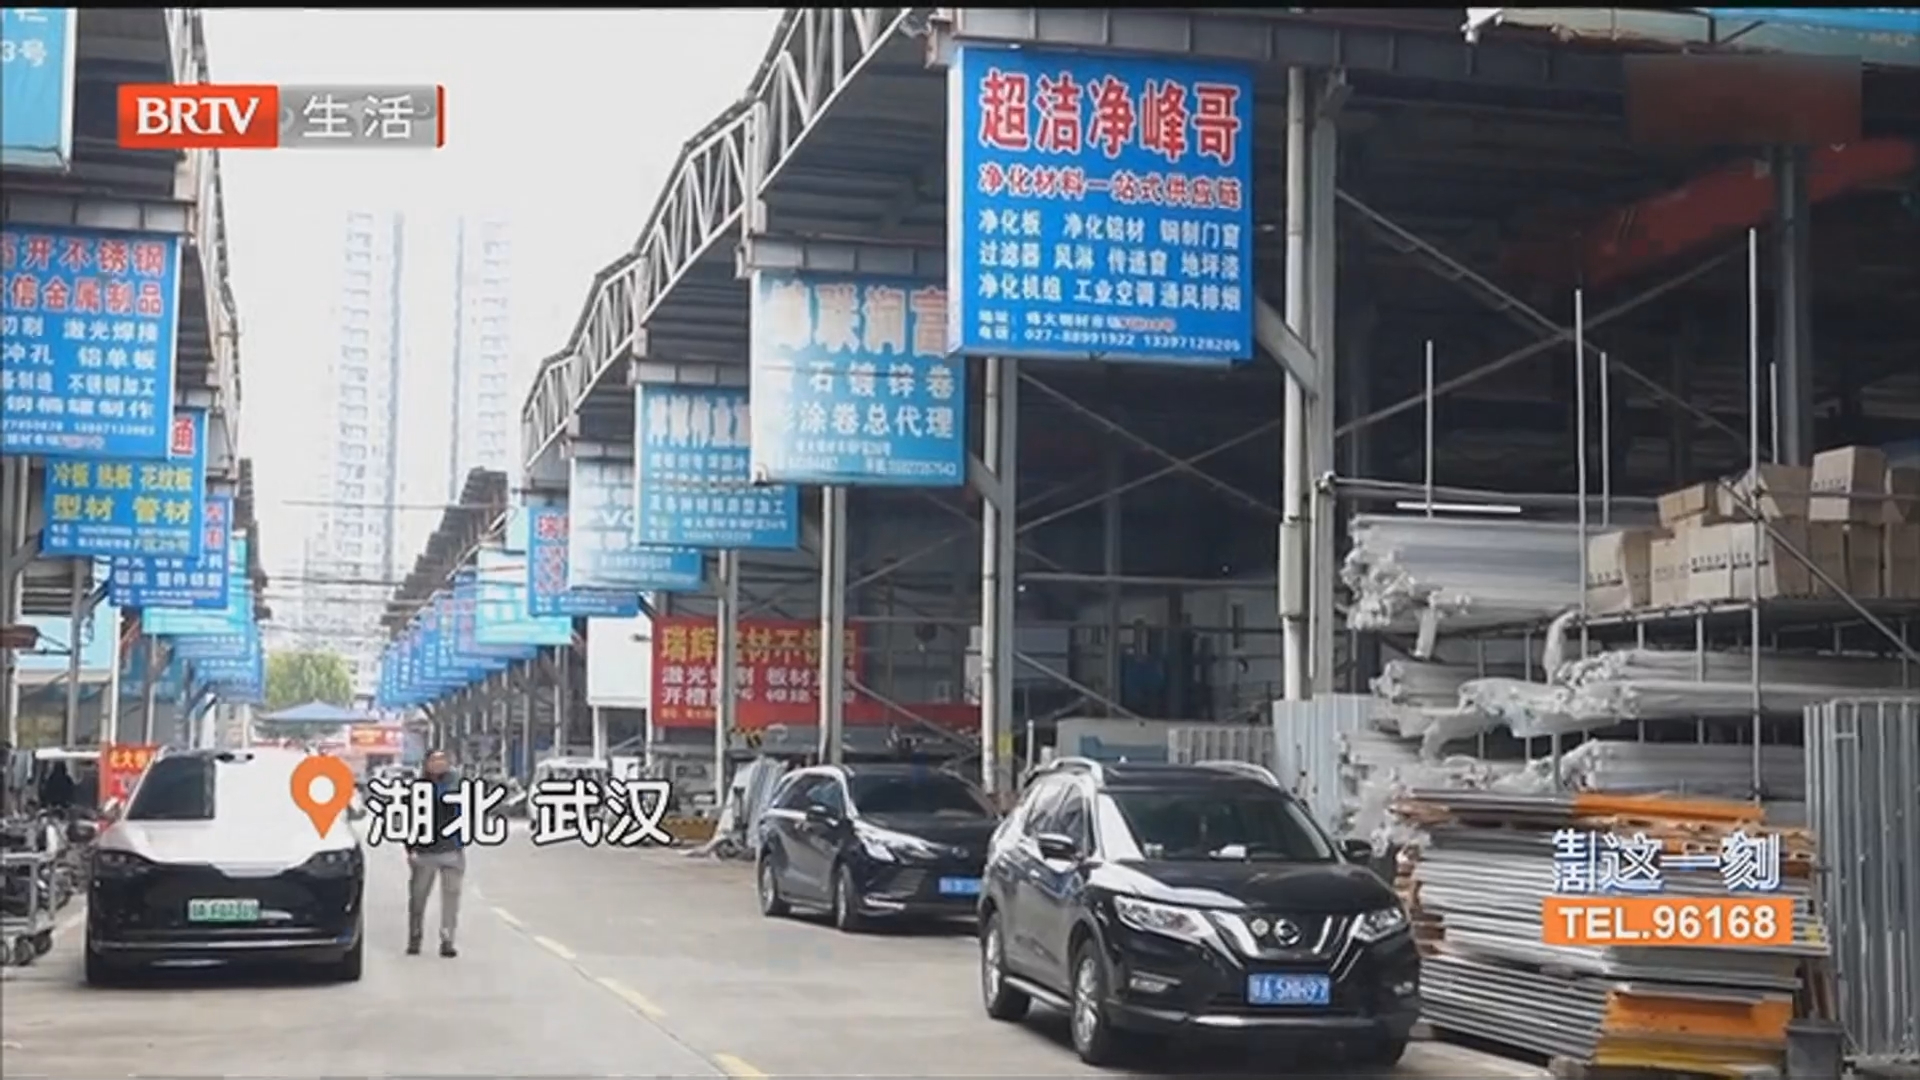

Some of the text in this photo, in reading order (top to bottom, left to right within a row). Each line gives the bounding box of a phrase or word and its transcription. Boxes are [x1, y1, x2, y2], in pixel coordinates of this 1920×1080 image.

[980, 67, 1241, 165] 超洁净峰哥
[979, 162, 1243, 209] 净化材料一站式供应链
[978, 208, 1240, 249] 净化板 净化铝材 钢制门窗
[979, 240, 1040, 268] 过滤器
[3, 274, 164, 318] 信金属制品
[1073, 278, 1155, 307] 工业空调
[63, 317, 160, 343] 激光焊接
[761, 360, 954, 400] 石镀锌卷
[772, 400, 954, 439] 涂卷总代理
[52, 493, 192, 524] 型材 管材
